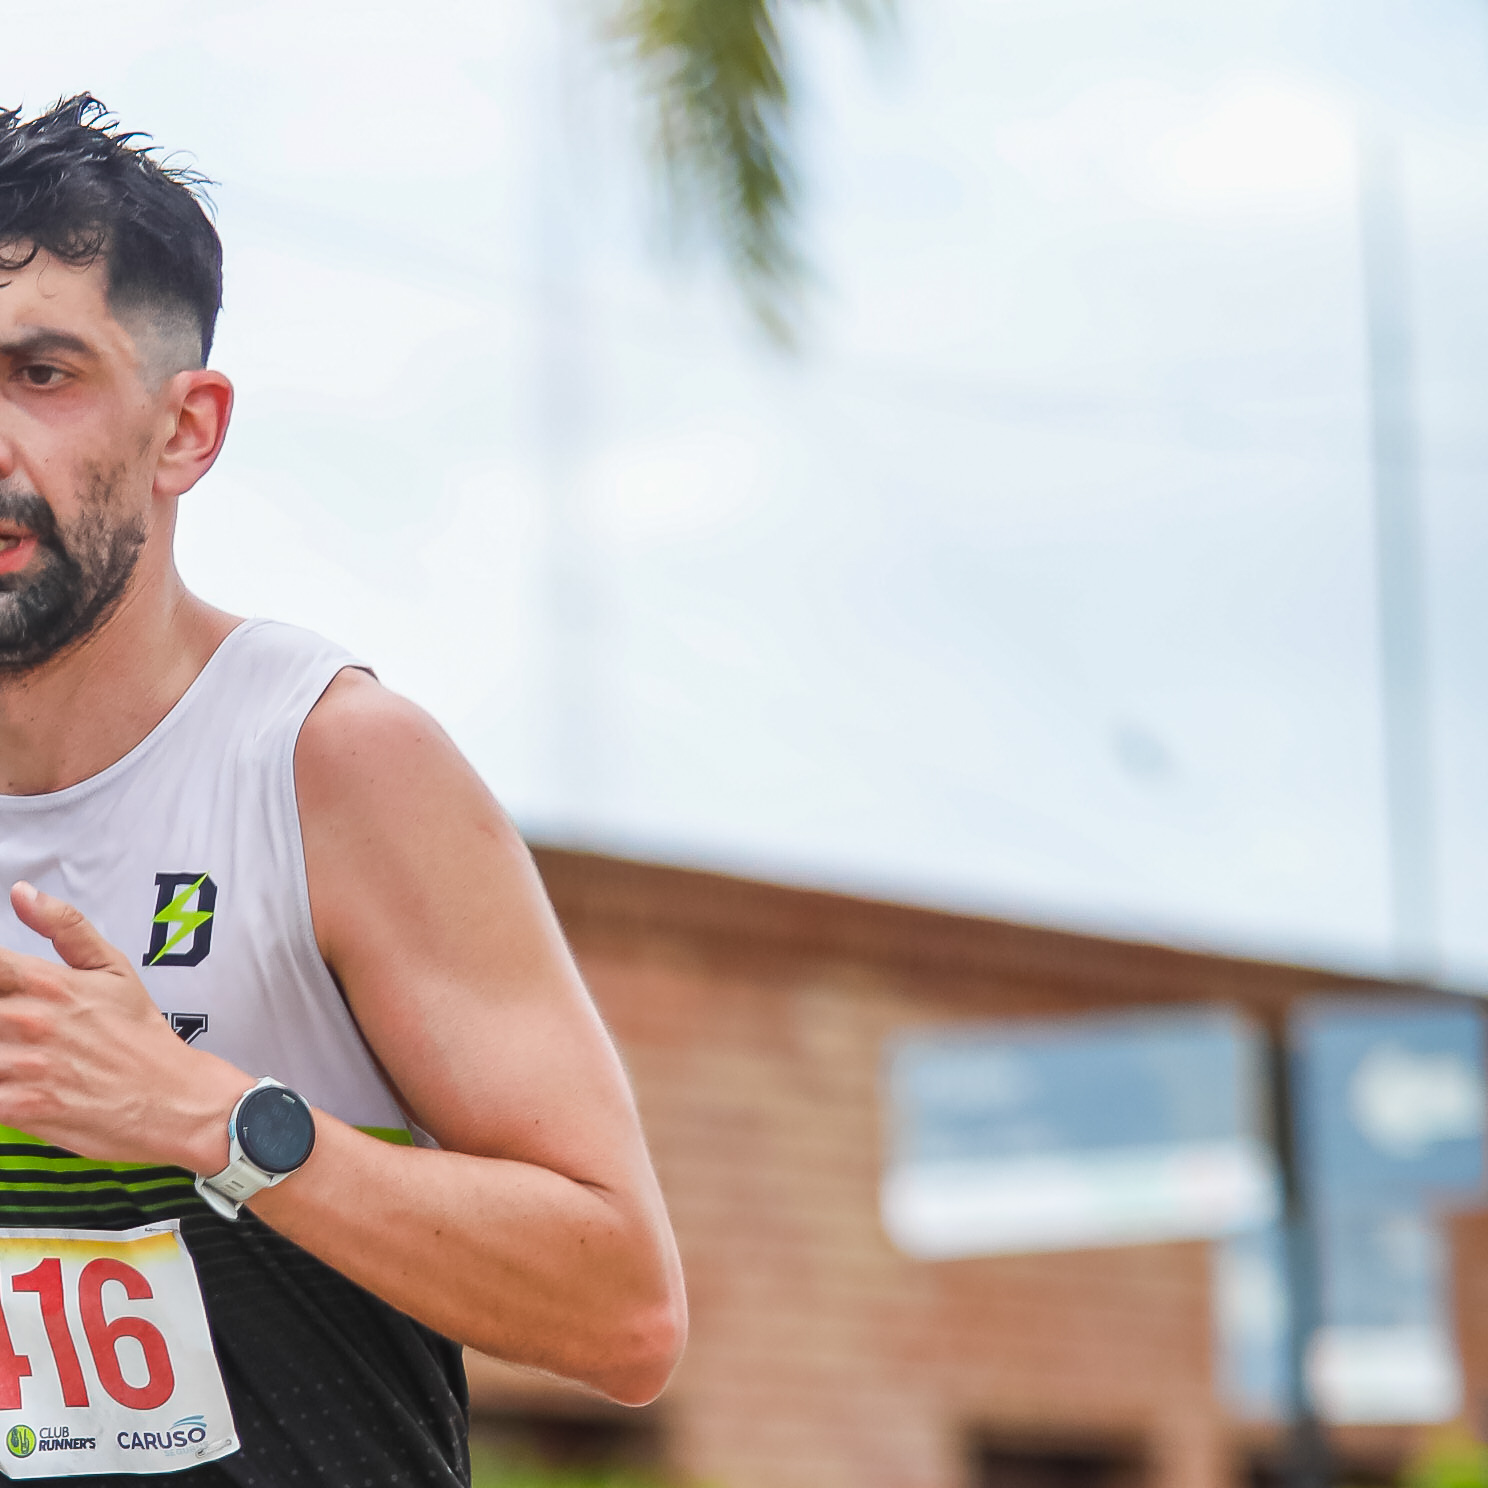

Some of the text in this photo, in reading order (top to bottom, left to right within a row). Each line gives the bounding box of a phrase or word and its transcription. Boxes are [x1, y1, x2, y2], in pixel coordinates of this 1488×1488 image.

[39, 1426, 70, 1439] CLUB
[117, 1427, 207, 1450] CARUSO
[38, 1437, 96, 1452] RUNNER'S
